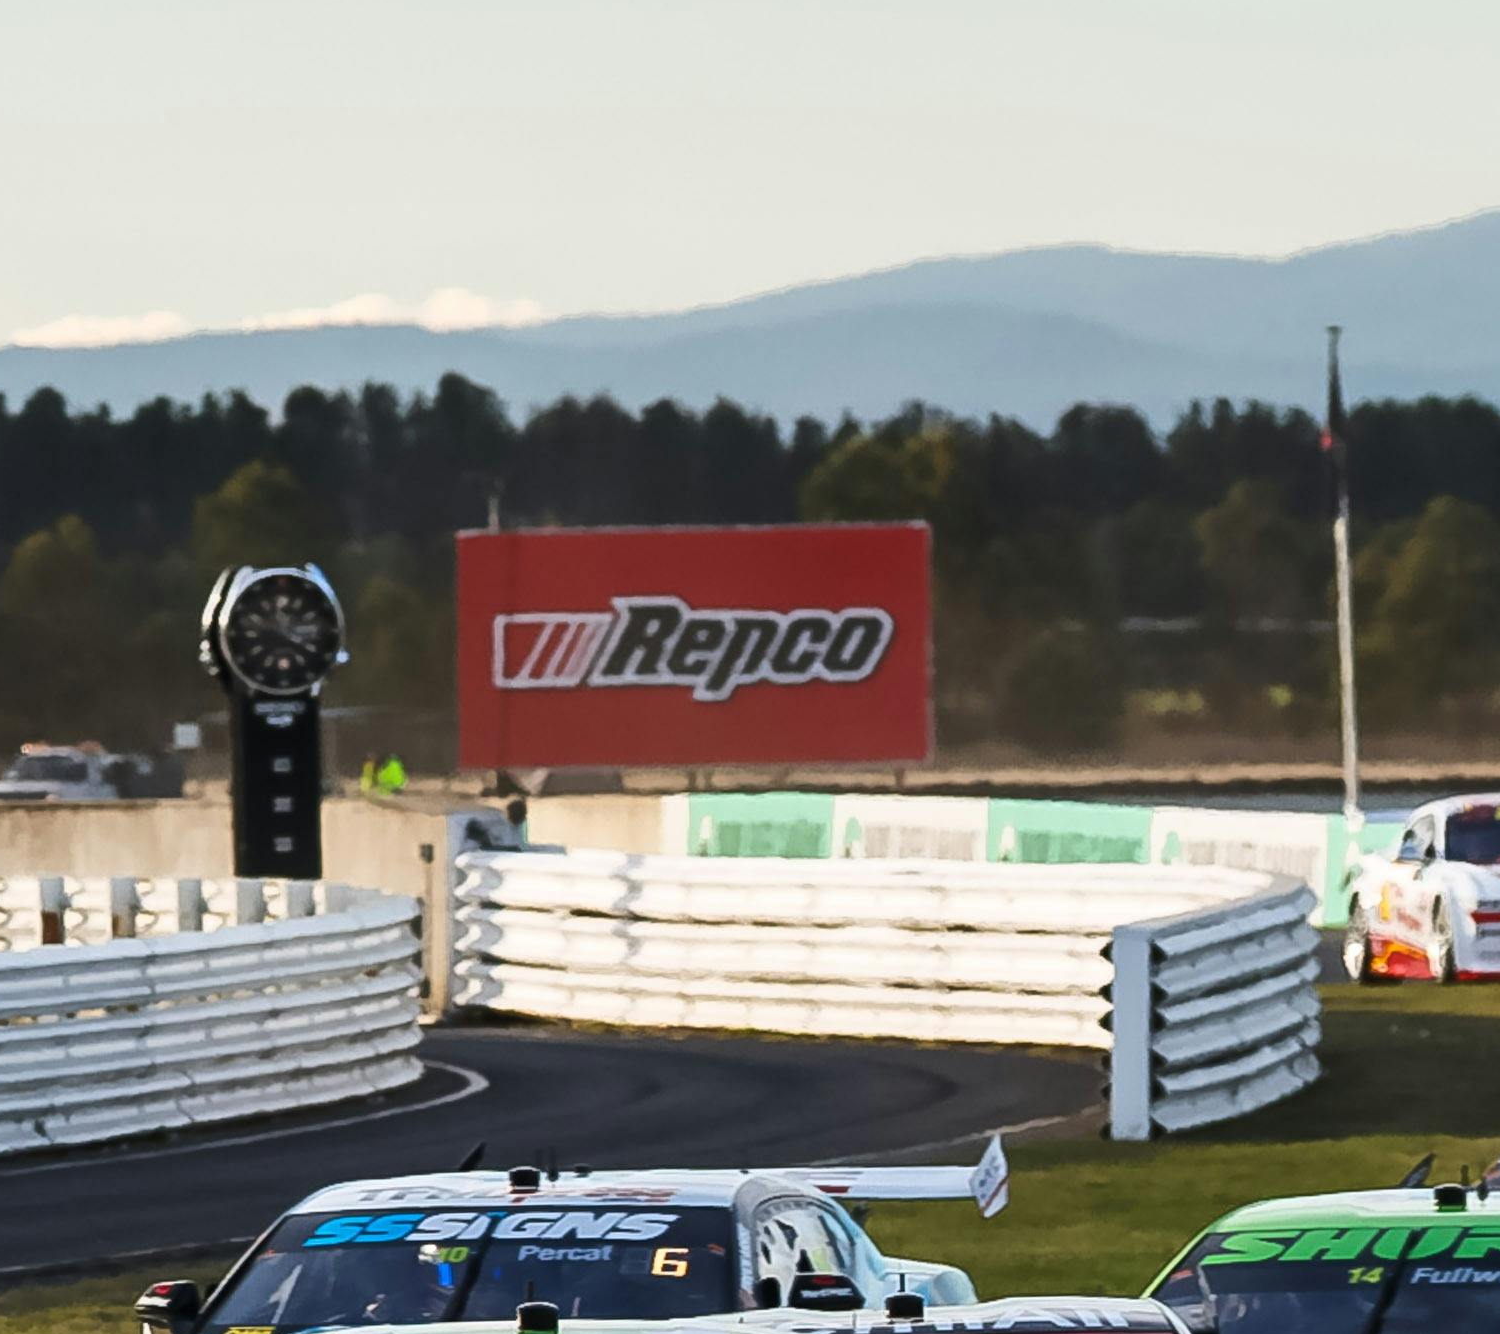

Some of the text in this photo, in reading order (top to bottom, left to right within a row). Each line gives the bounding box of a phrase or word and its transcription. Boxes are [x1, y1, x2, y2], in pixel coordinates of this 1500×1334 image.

[603, 602, 886, 693] Repco
[517, 1244, 614, 1262] Percat
[650, 1246, 690, 1278] 6
